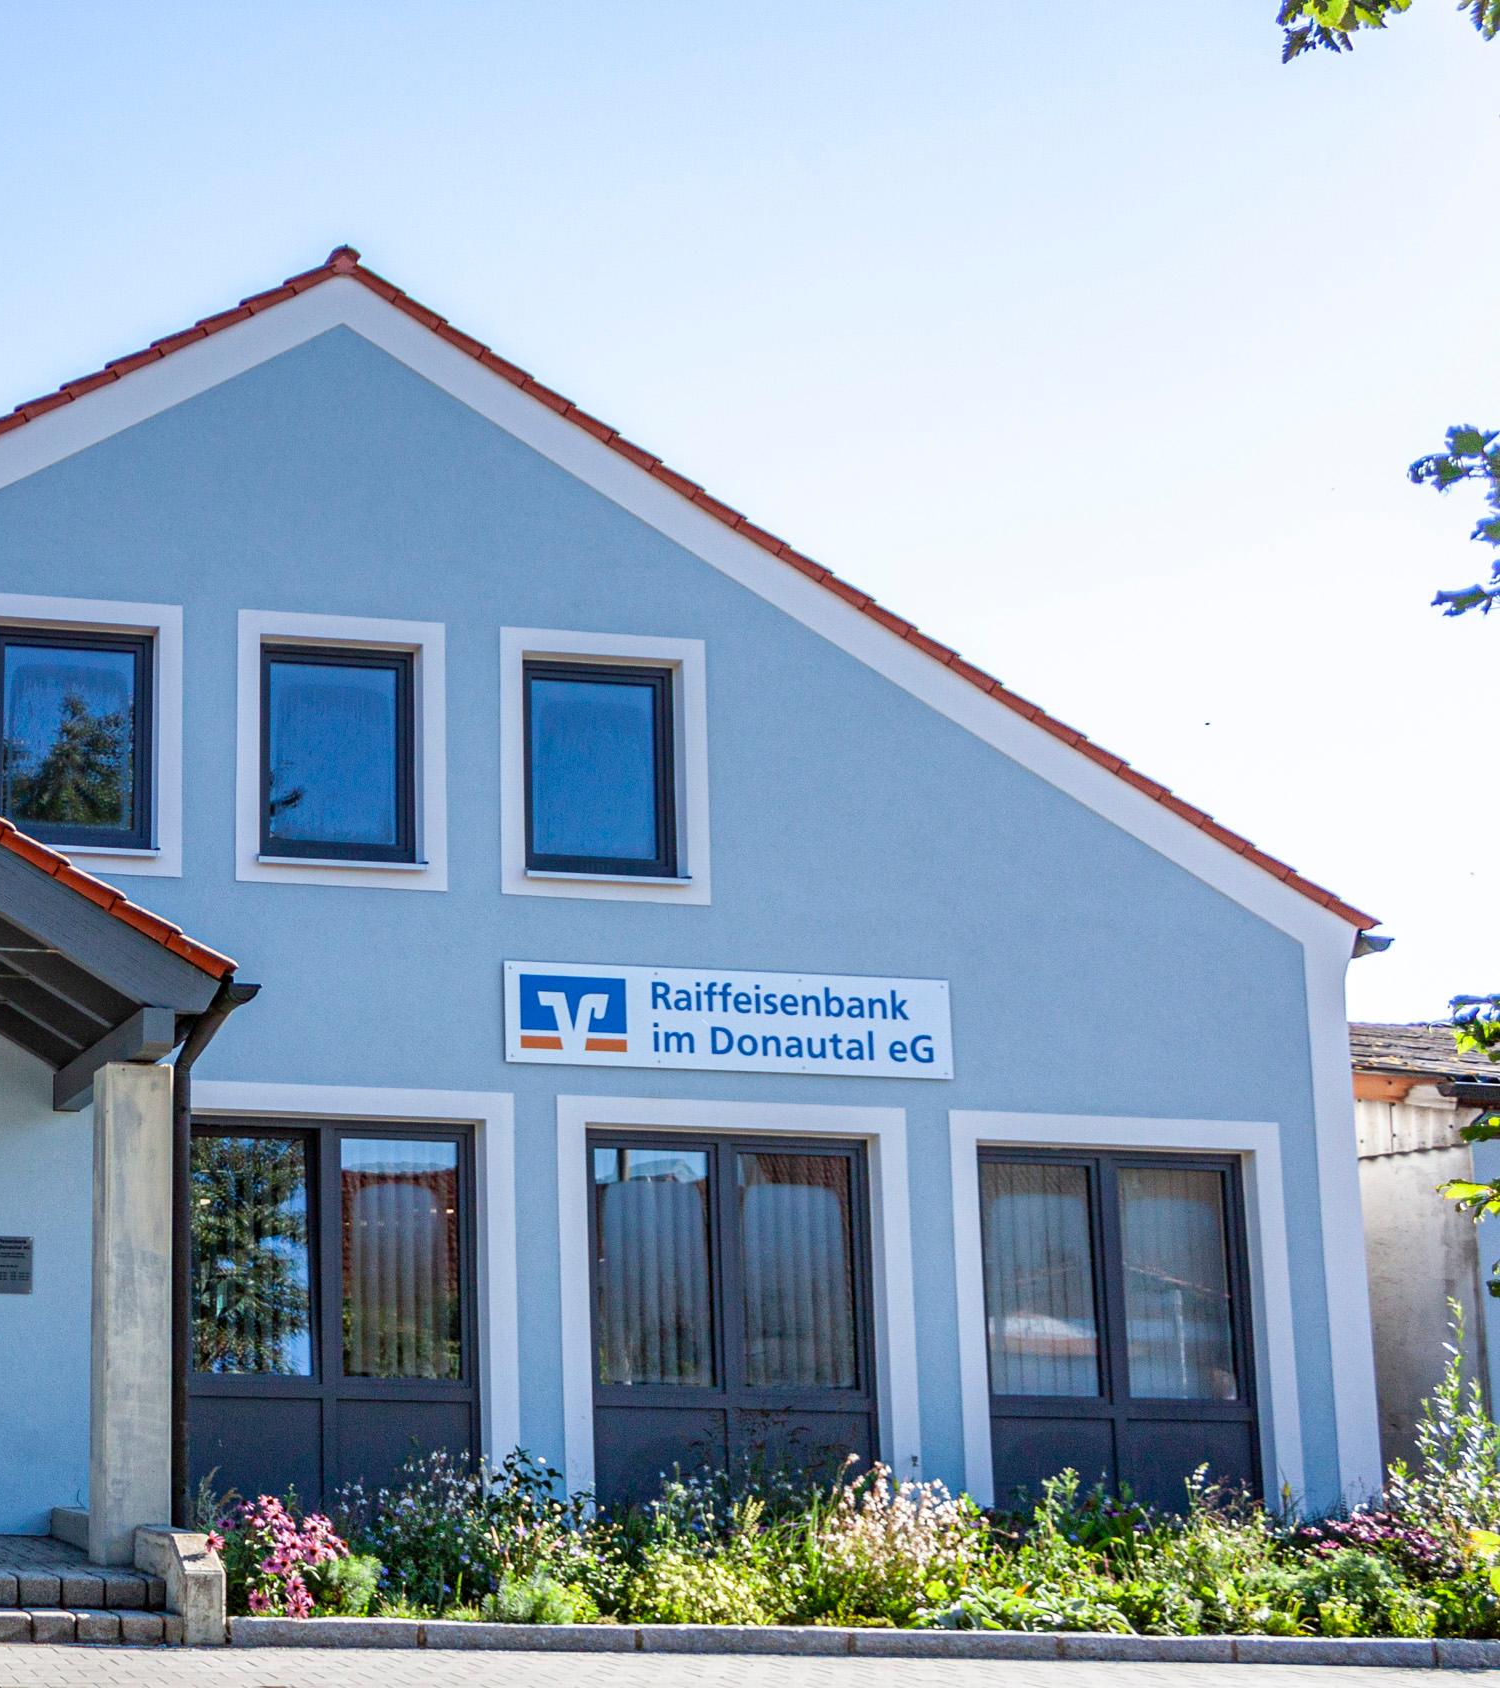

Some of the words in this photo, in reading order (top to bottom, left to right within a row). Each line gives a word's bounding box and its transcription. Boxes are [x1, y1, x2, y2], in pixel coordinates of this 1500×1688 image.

[651, 981, 910, 1021] Raiffeisenbank
[652, 1022, 695, 1054] im
[710, 1026, 875, 1062] Donautal
[888, 1033, 935, 1064] eG
